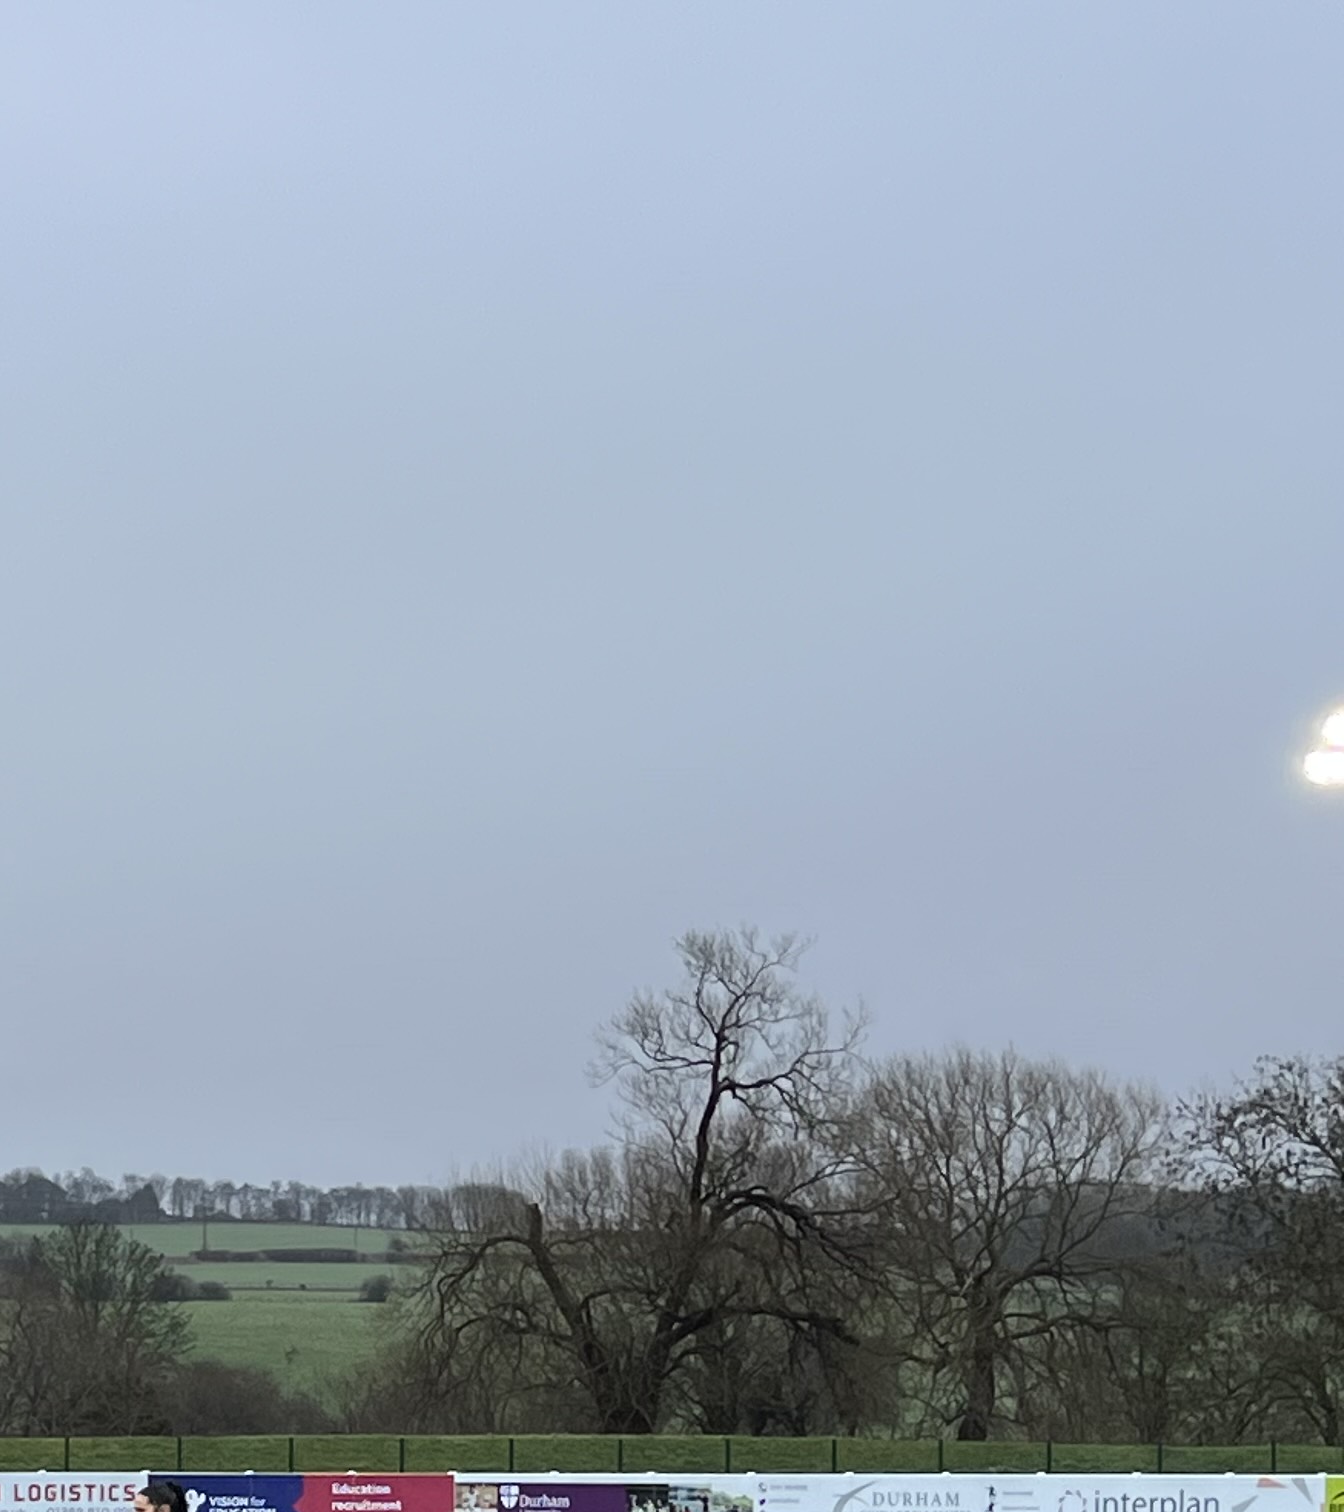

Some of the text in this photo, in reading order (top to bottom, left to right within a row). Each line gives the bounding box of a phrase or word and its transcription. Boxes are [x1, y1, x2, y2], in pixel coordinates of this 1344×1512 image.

[13, 1484, 136, 1502] LOGISTICS
[331, 1483, 392, 1495] Education
[209, 1496, 266, 1507] VISION for
[331, 1498, 402, 1511] recruitment
[519, 1493, 571, 1508] Durham
[872, 1492, 961, 1506] DURHAM
